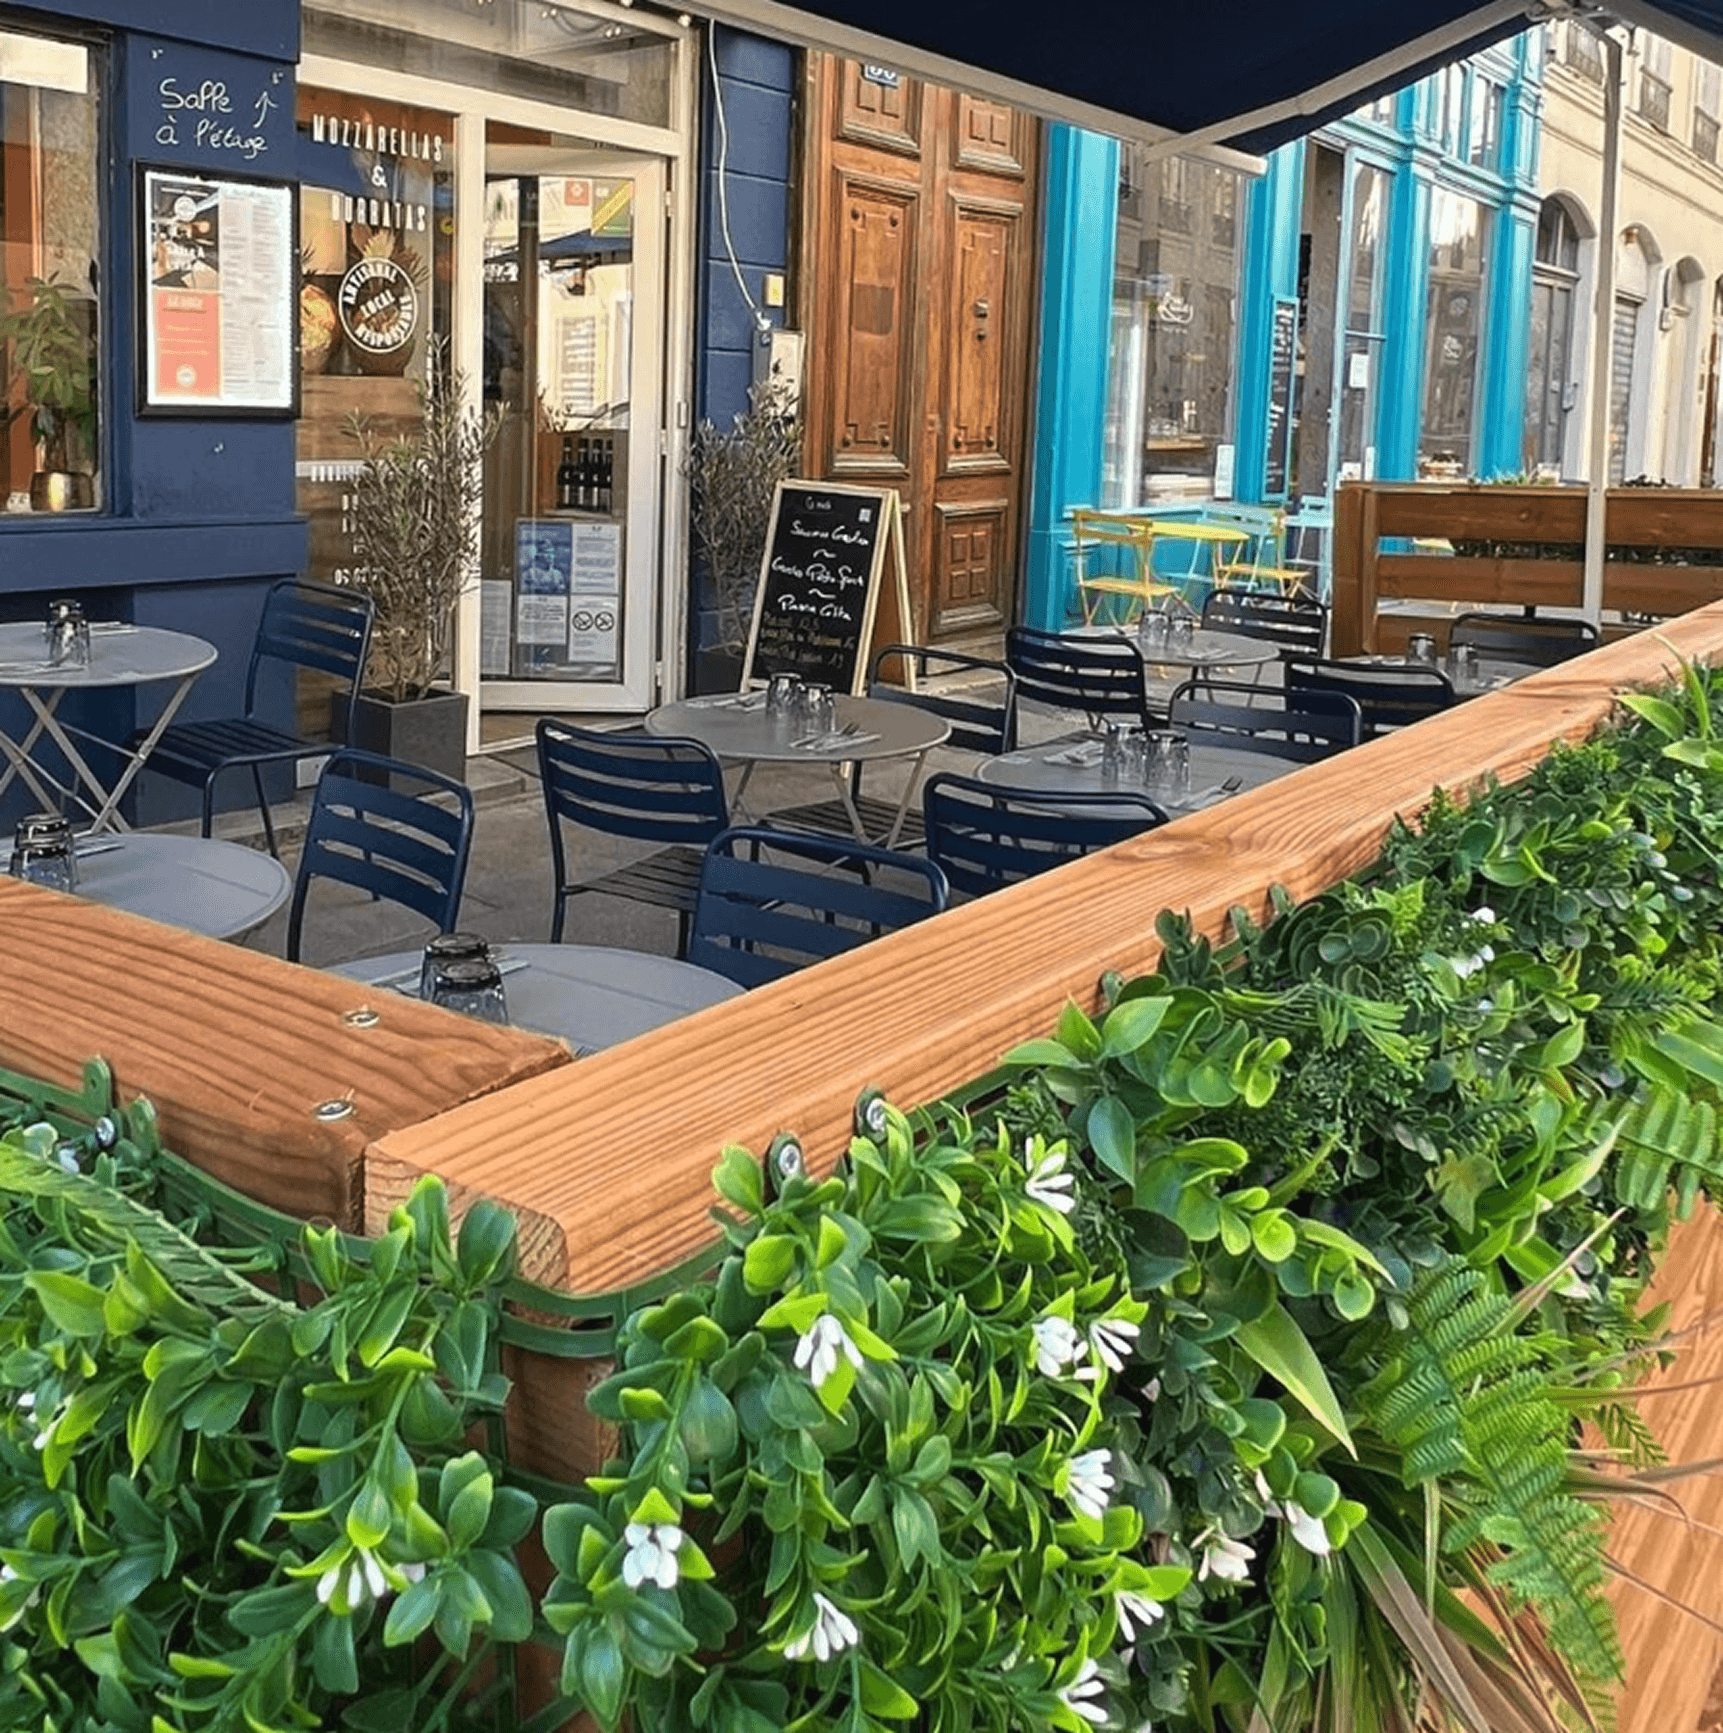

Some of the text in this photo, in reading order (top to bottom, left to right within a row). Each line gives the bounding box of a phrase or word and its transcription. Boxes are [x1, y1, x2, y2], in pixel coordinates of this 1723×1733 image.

[159, 77, 234, 113] Salle
[155, 114, 269, 160] à l'étage
[313, 113, 442, 162] MOZZARELLAS
[371, 164, 388, 188] &
[360, 288, 396, 319] LOCAL
